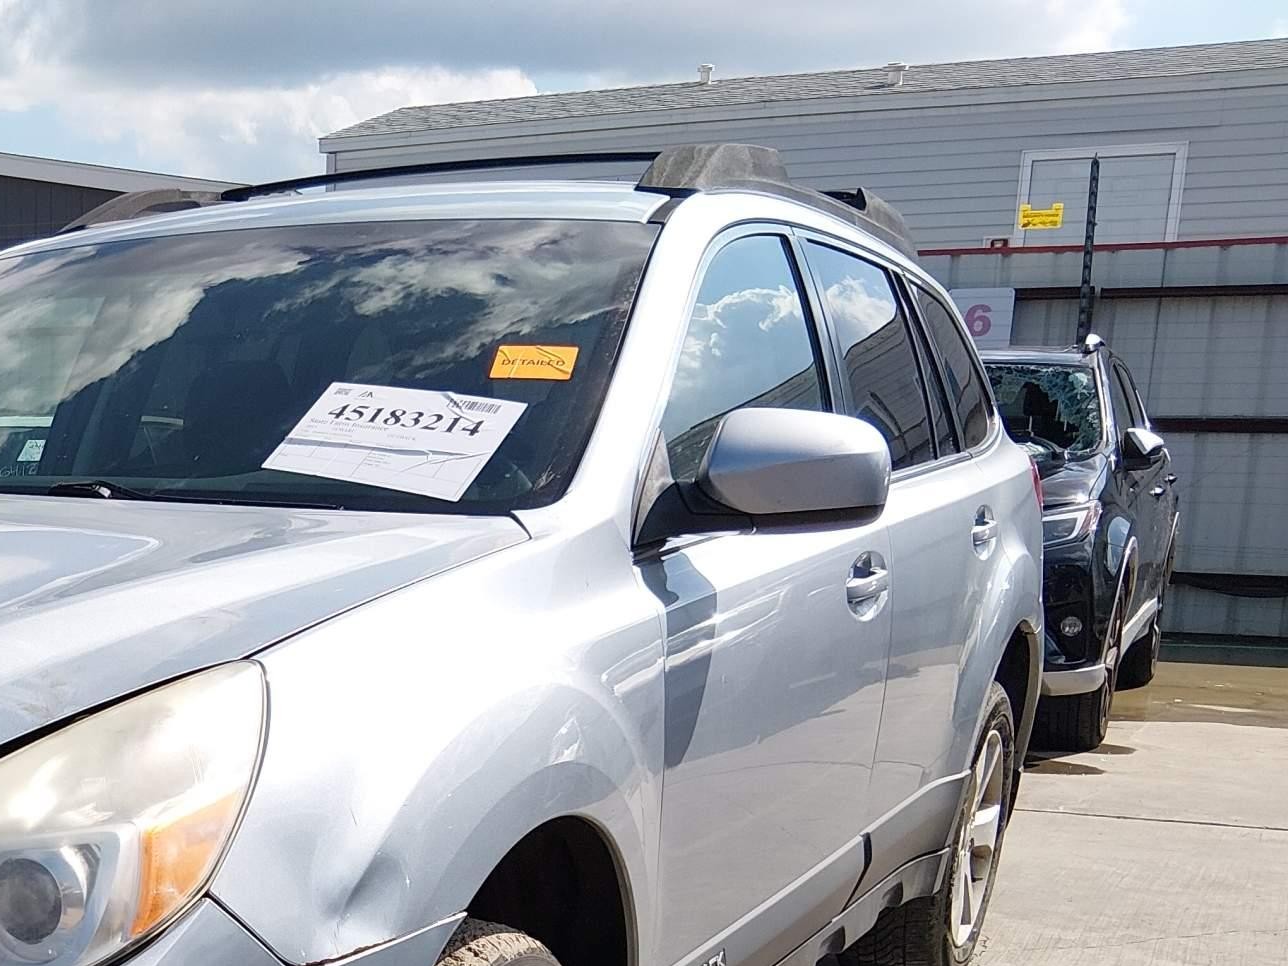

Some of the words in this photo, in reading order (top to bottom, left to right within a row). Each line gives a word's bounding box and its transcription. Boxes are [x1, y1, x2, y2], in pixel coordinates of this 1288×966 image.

[963, 303, 992, 337] 6
[501, 357, 566, 367] DETAILED
[328, 403, 486, 437] 45183214
